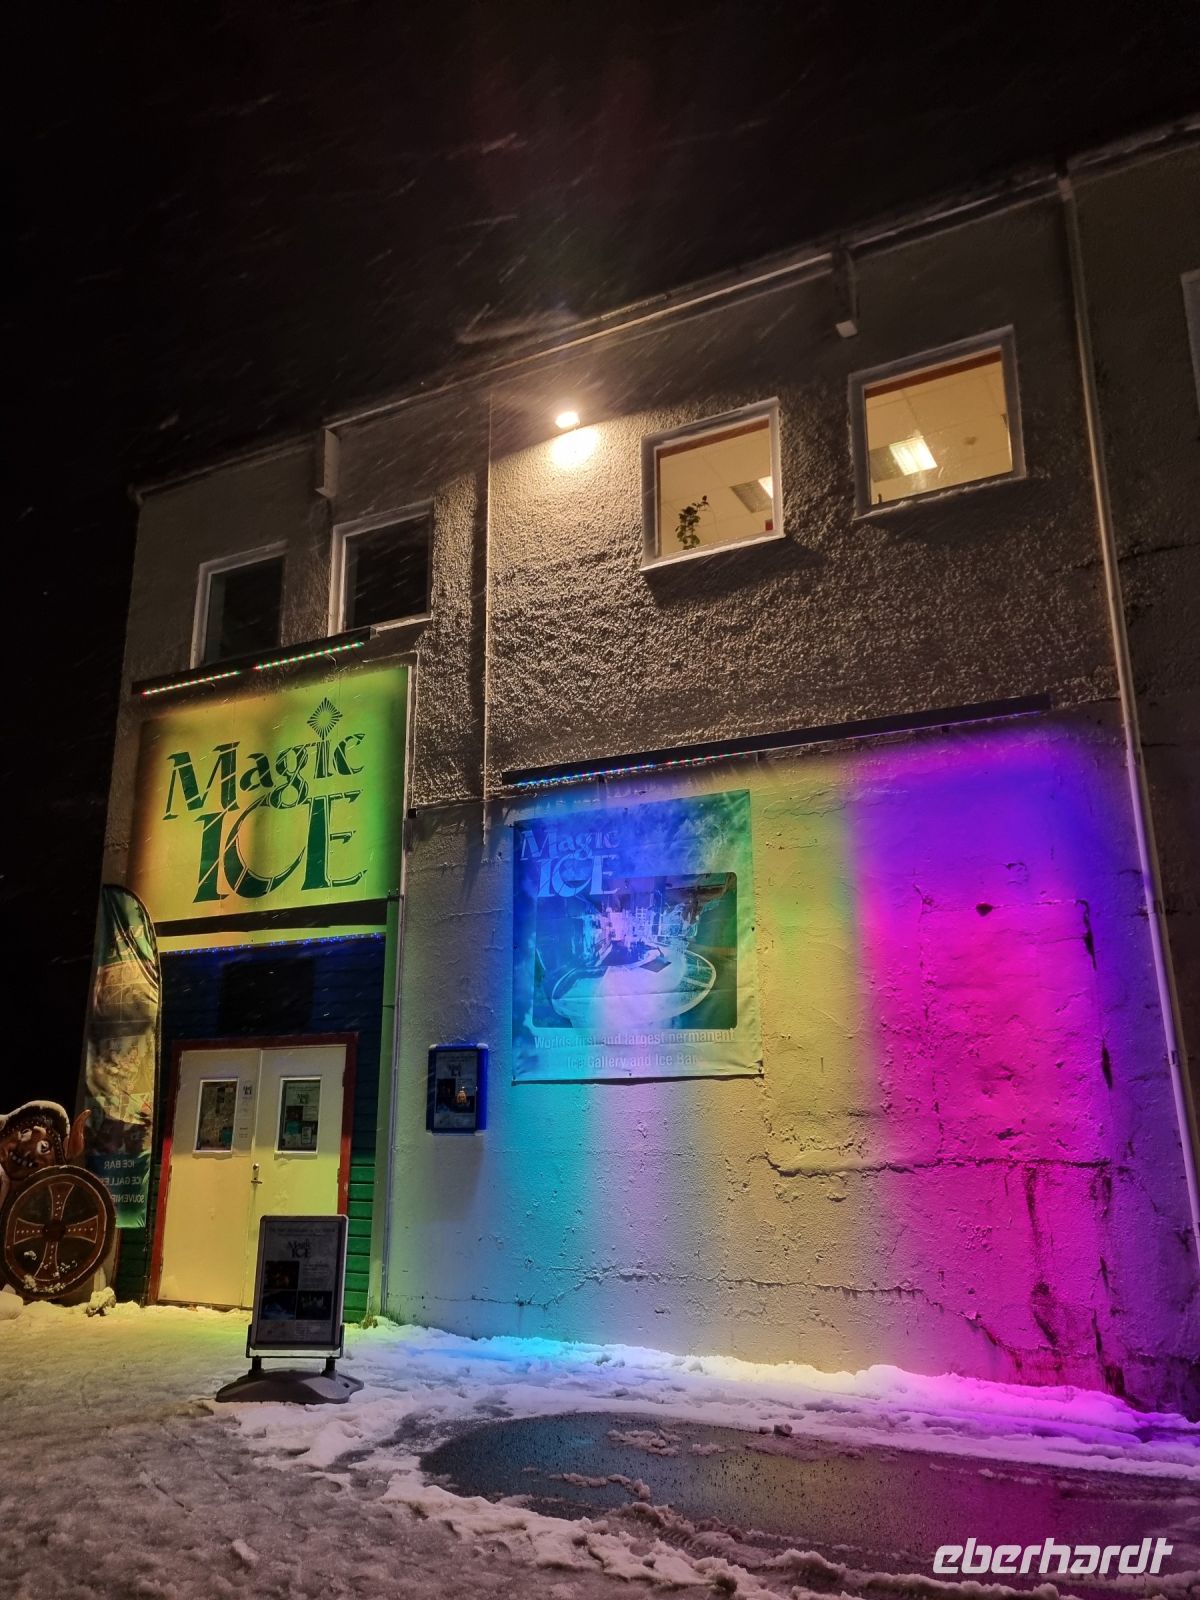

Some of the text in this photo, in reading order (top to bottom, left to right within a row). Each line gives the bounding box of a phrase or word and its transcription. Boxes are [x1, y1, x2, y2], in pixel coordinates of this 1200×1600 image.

[166, 698, 365, 820] Magic
[192, 789, 367, 903] ICE
[520, 830, 619, 861] Magic
[536, 854, 618, 898] ICE
[600, 1033, 620, 1046] and
[624, 1031, 664, 1047] largest
[588, 1055, 626, 1070] Gallery
[630, 1053, 651, 1066] and
[655, 1053, 673, 1065] Ice
[677, 1052, 697, 1065] Bar
